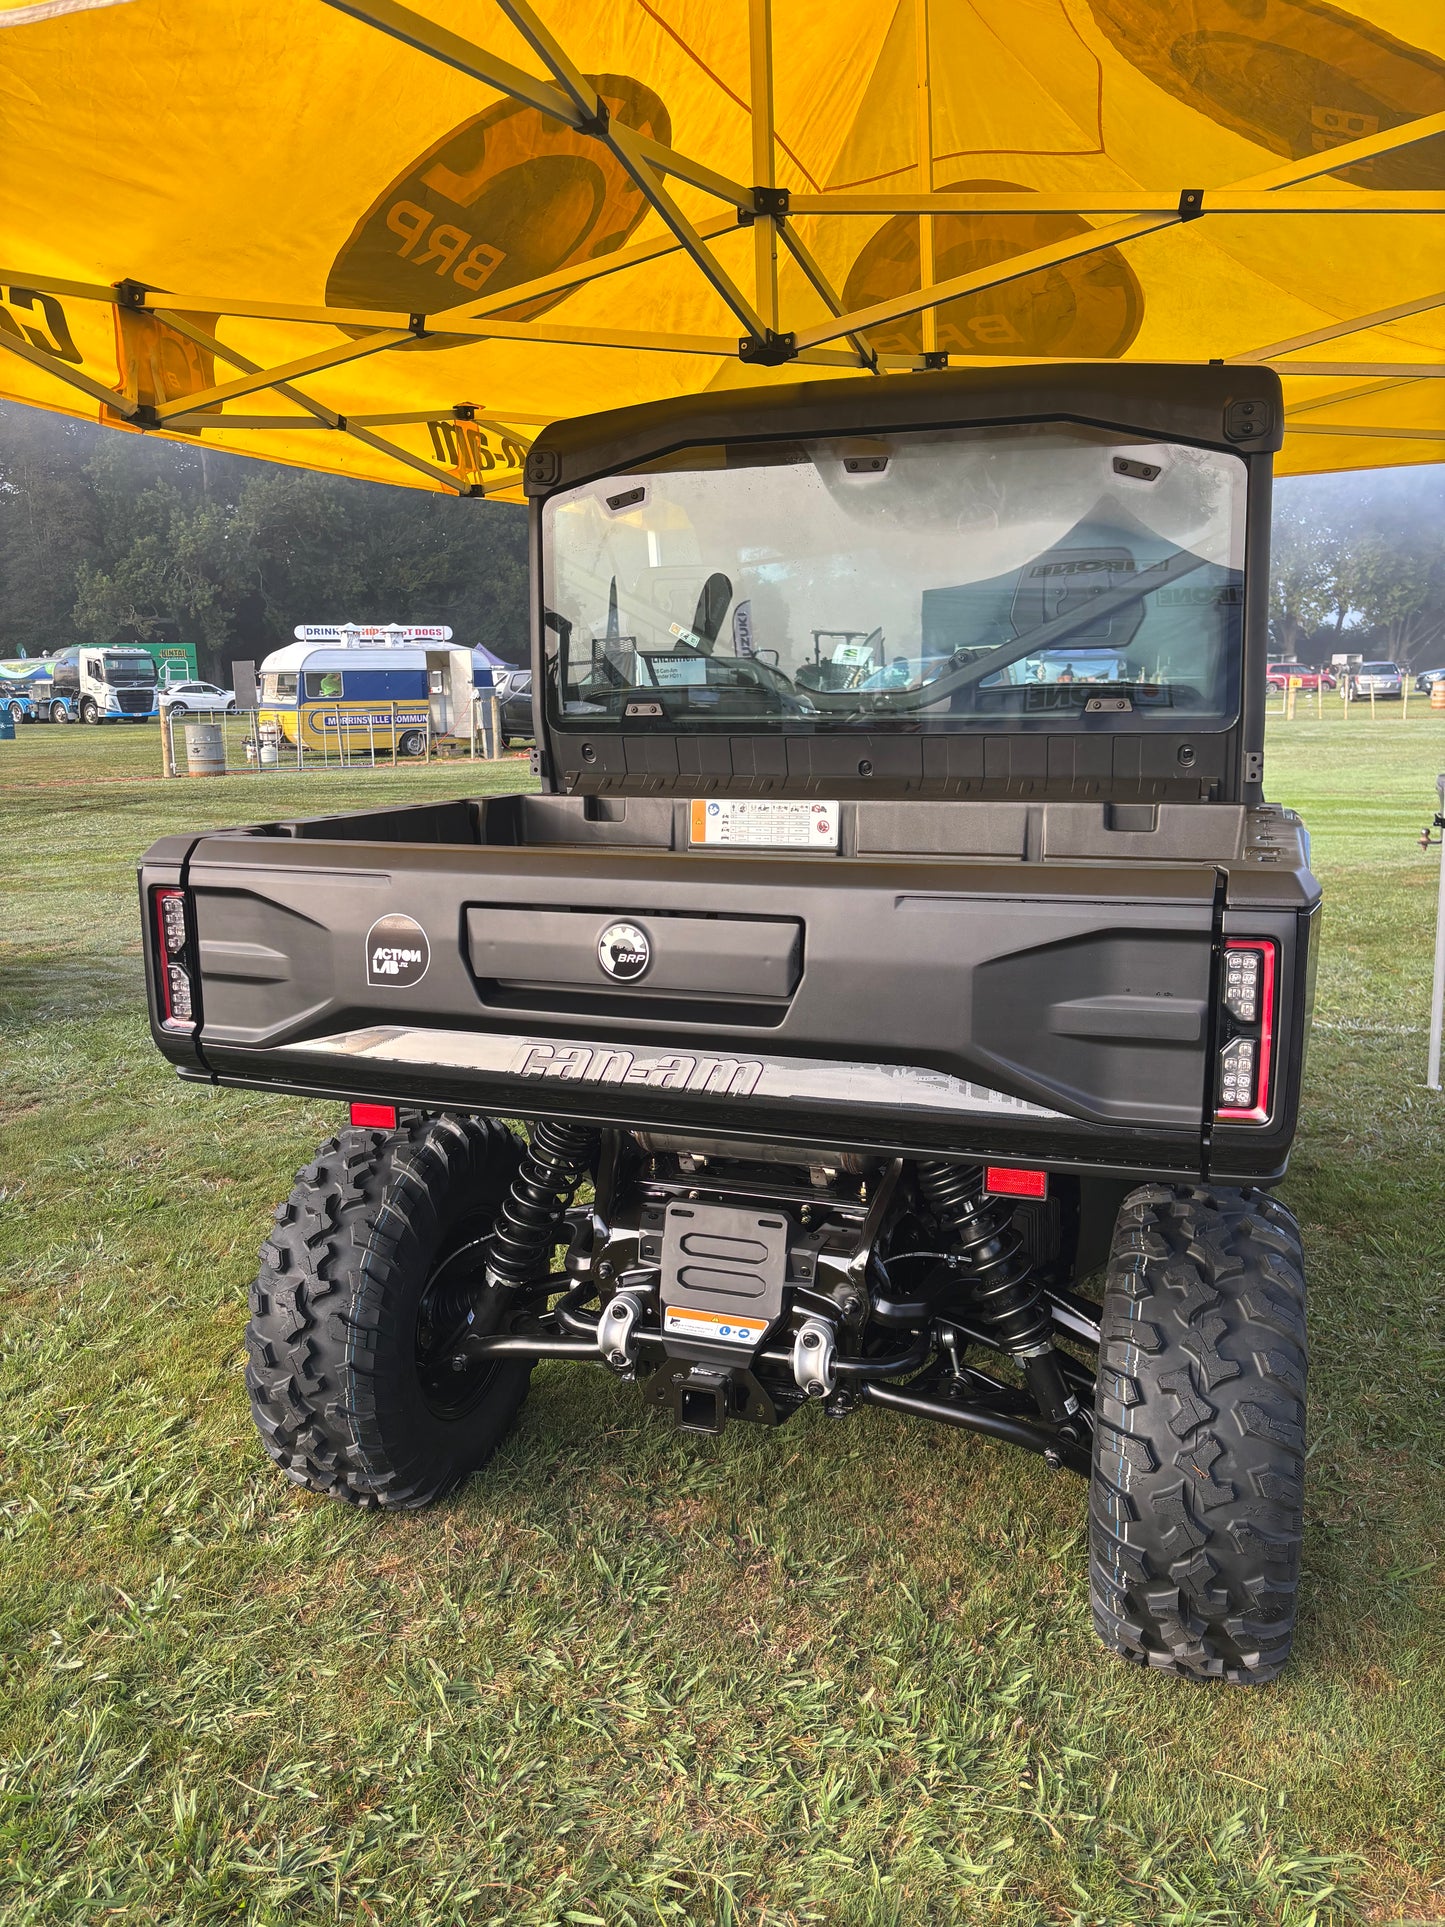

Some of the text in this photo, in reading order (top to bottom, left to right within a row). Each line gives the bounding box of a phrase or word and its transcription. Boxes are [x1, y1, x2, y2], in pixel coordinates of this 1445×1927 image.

[306, 627, 341, 636] DRINK
[415, 628, 442, 636] DOGS
[737, 612, 753, 656] UZUKI
[327, 713, 428, 726] MRRINSVILLE OMMUN
[618, 953, 646, 963] BRP
